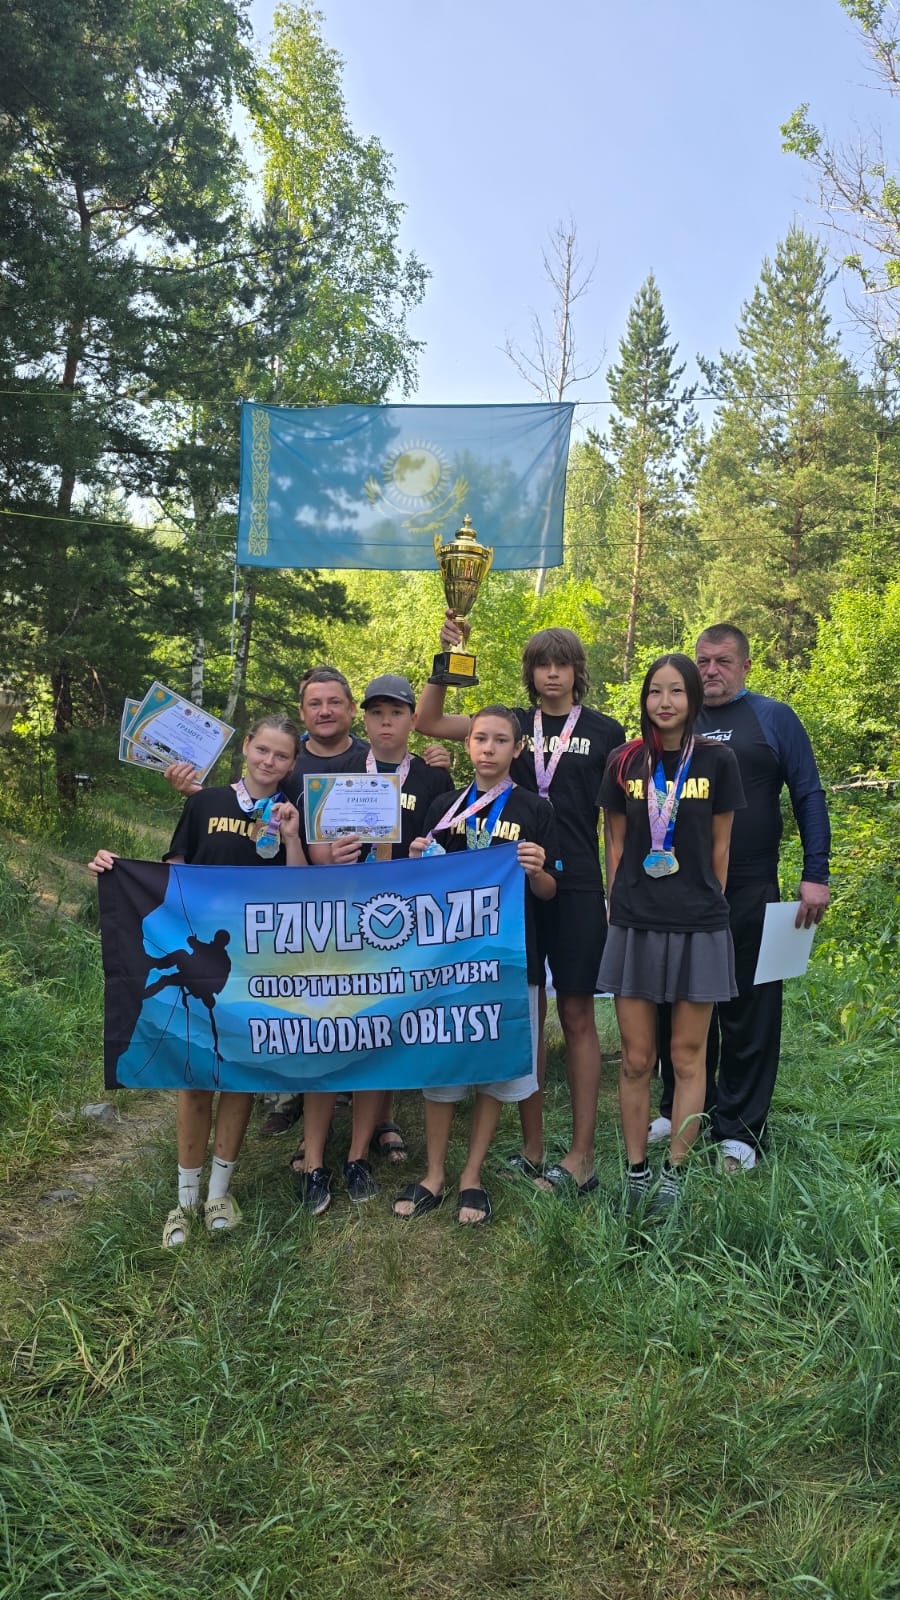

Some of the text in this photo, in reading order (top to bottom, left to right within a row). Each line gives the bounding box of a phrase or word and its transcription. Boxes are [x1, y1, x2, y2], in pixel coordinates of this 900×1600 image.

[245, 885, 500, 953] PAVLODAR
[248, 959, 500, 998] СПОРТИВНЫЙ ТУРИЗМ
[249, 1002, 502, 1055] PAVLODAR OBLYSY
